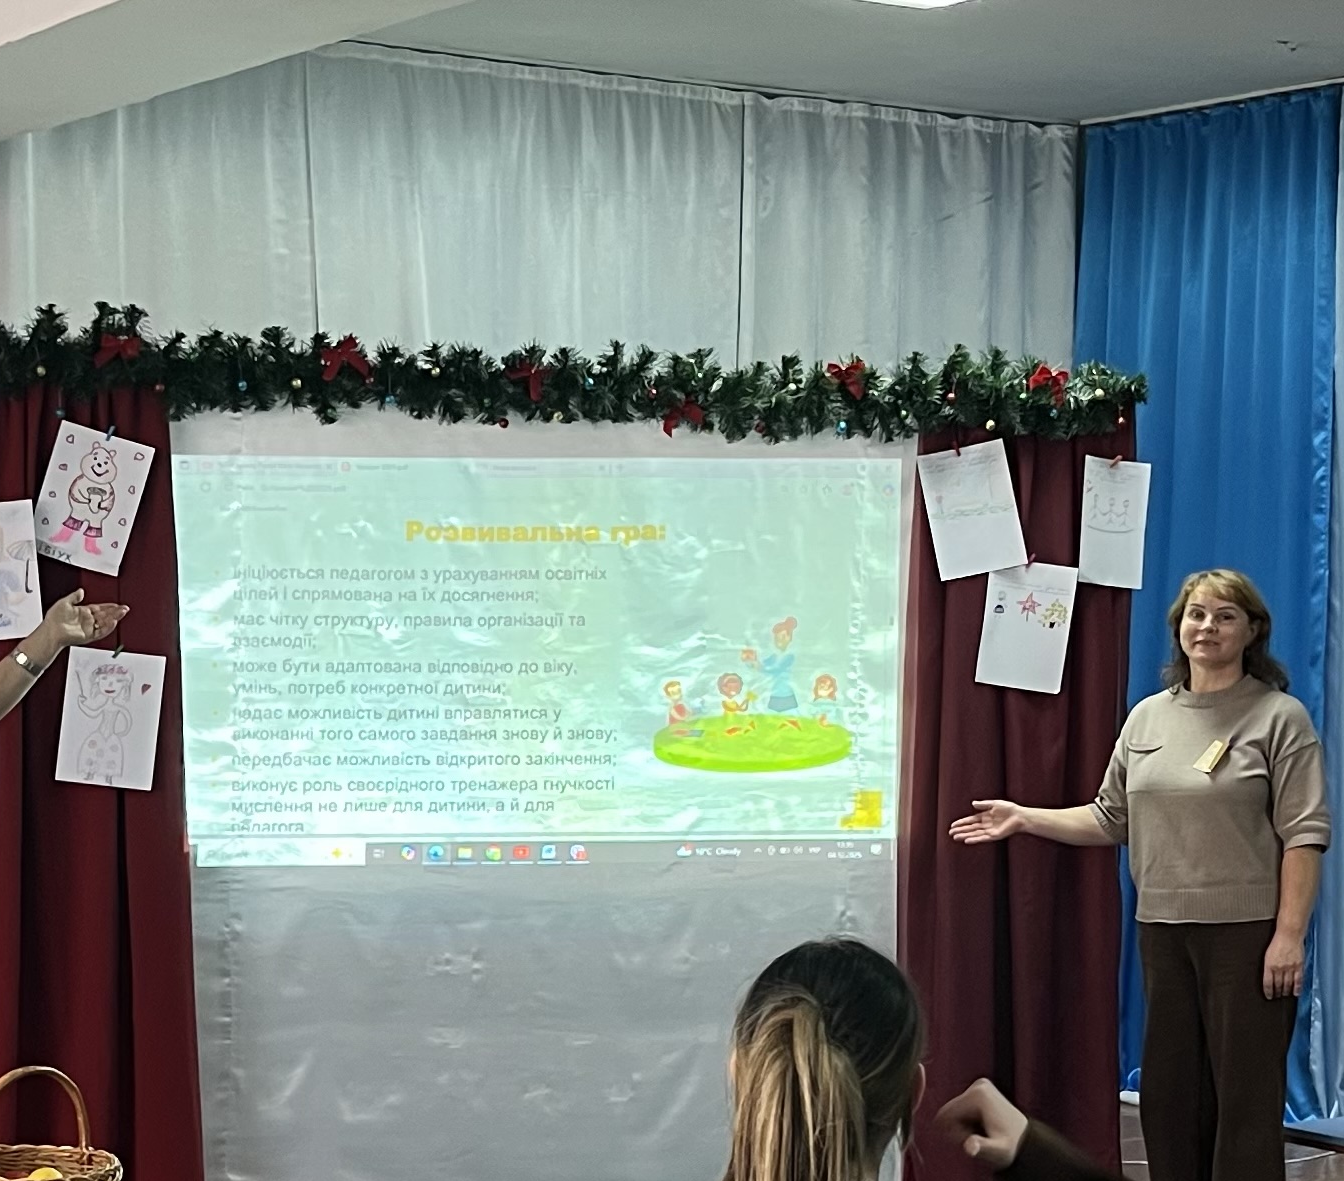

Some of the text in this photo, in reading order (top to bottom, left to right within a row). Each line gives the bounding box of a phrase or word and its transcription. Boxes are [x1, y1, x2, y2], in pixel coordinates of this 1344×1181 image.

[404, 521, 666, 547] Розвивальна гра:
[233, 565, 607, 584] ініціюється педагогом з урахуванням освітніх
[233, 586, 279, 602] цілей
[292, 587, 393, 604] спрямована
[398, 589, 417, 601] на
[422, 588, 436, 601] їх
[440, 589, 539, 604] досягнення;
[233, 612, 586, 630] має чітку структуру, правила організації та
[232, 632, 317, 650] взаємодії;
[232, 658, 578, 676] може бути адаптована відповідно до віку,
[232, 679, 507, 697] умінь, потреб конкретної дитини;
[232, 705, 562, 723] надає можливість дитині вправлятися у
[232, 726, 618, 744] виконанні того самого завдання знову й знову;
[232, 751, 617, 769] передбачає можливість відкритого закінчення;
[231, 776, 615, 795] виконує роль своєрідного тренажера гнучкості
[231, 798, 555, 814] мислення не лише для дитини, а й для
